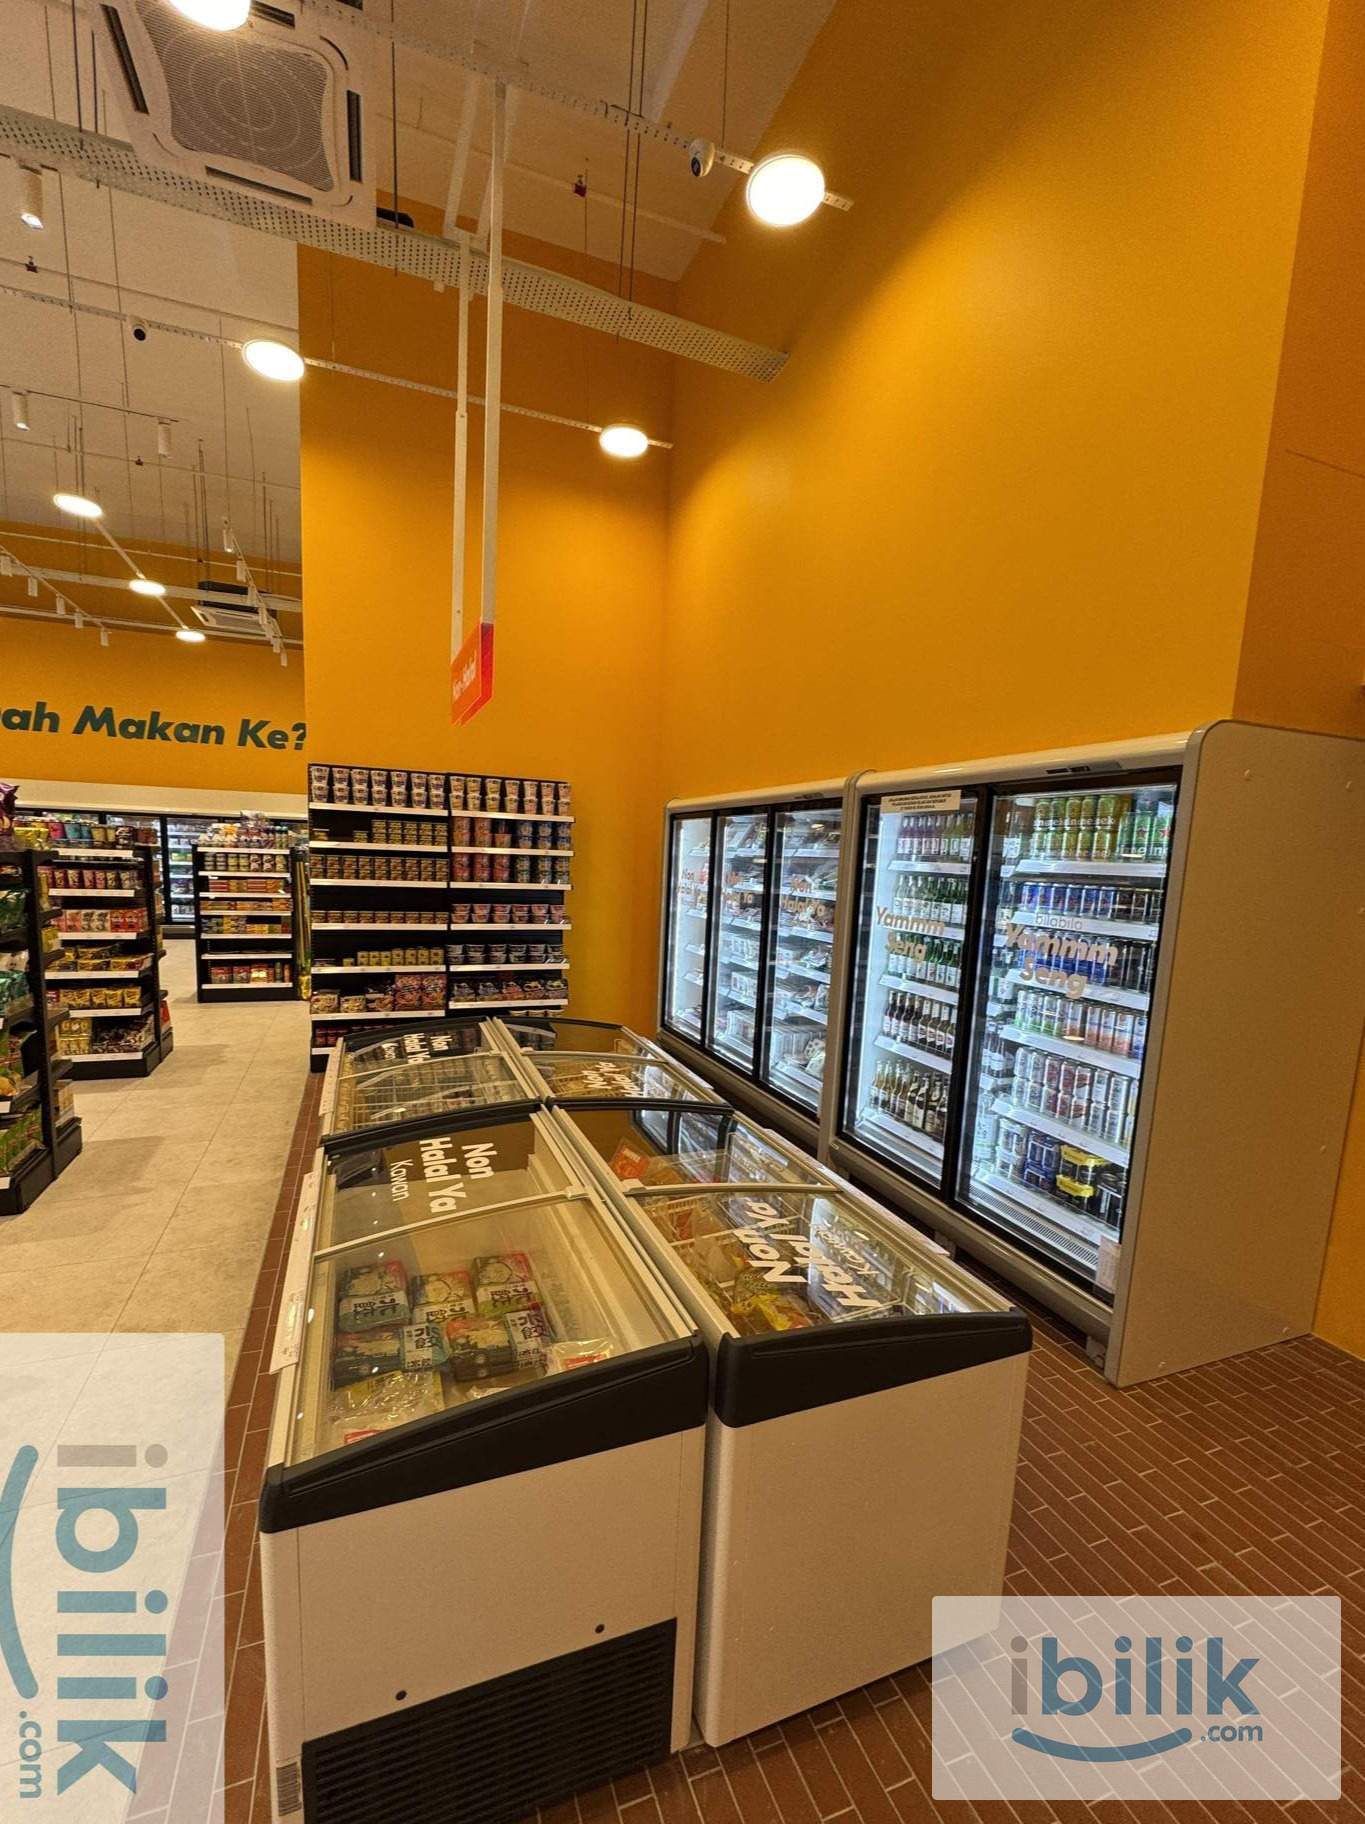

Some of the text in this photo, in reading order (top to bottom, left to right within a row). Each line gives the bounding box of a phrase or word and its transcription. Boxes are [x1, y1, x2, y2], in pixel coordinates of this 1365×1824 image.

[0, 701, 306, 750] ah Makan Ke?
[876, 905, 945, 937] Yammm
[1007, 923, 1118, 966] Yammm
[1019, 957, 1088, 999] Seng
[403, 1033, 429, 1052] Halal
[430, 1035, 452, 1051] Non
[390, 1159, 414, 1201] Kawan
[419, 1137, 467, 1213] Halal Ya
[461, 1143, 498, 1179] Non
[733, 1228, 808, 1282] Non
[744, 1201, 883, 1307] Halal Ya
